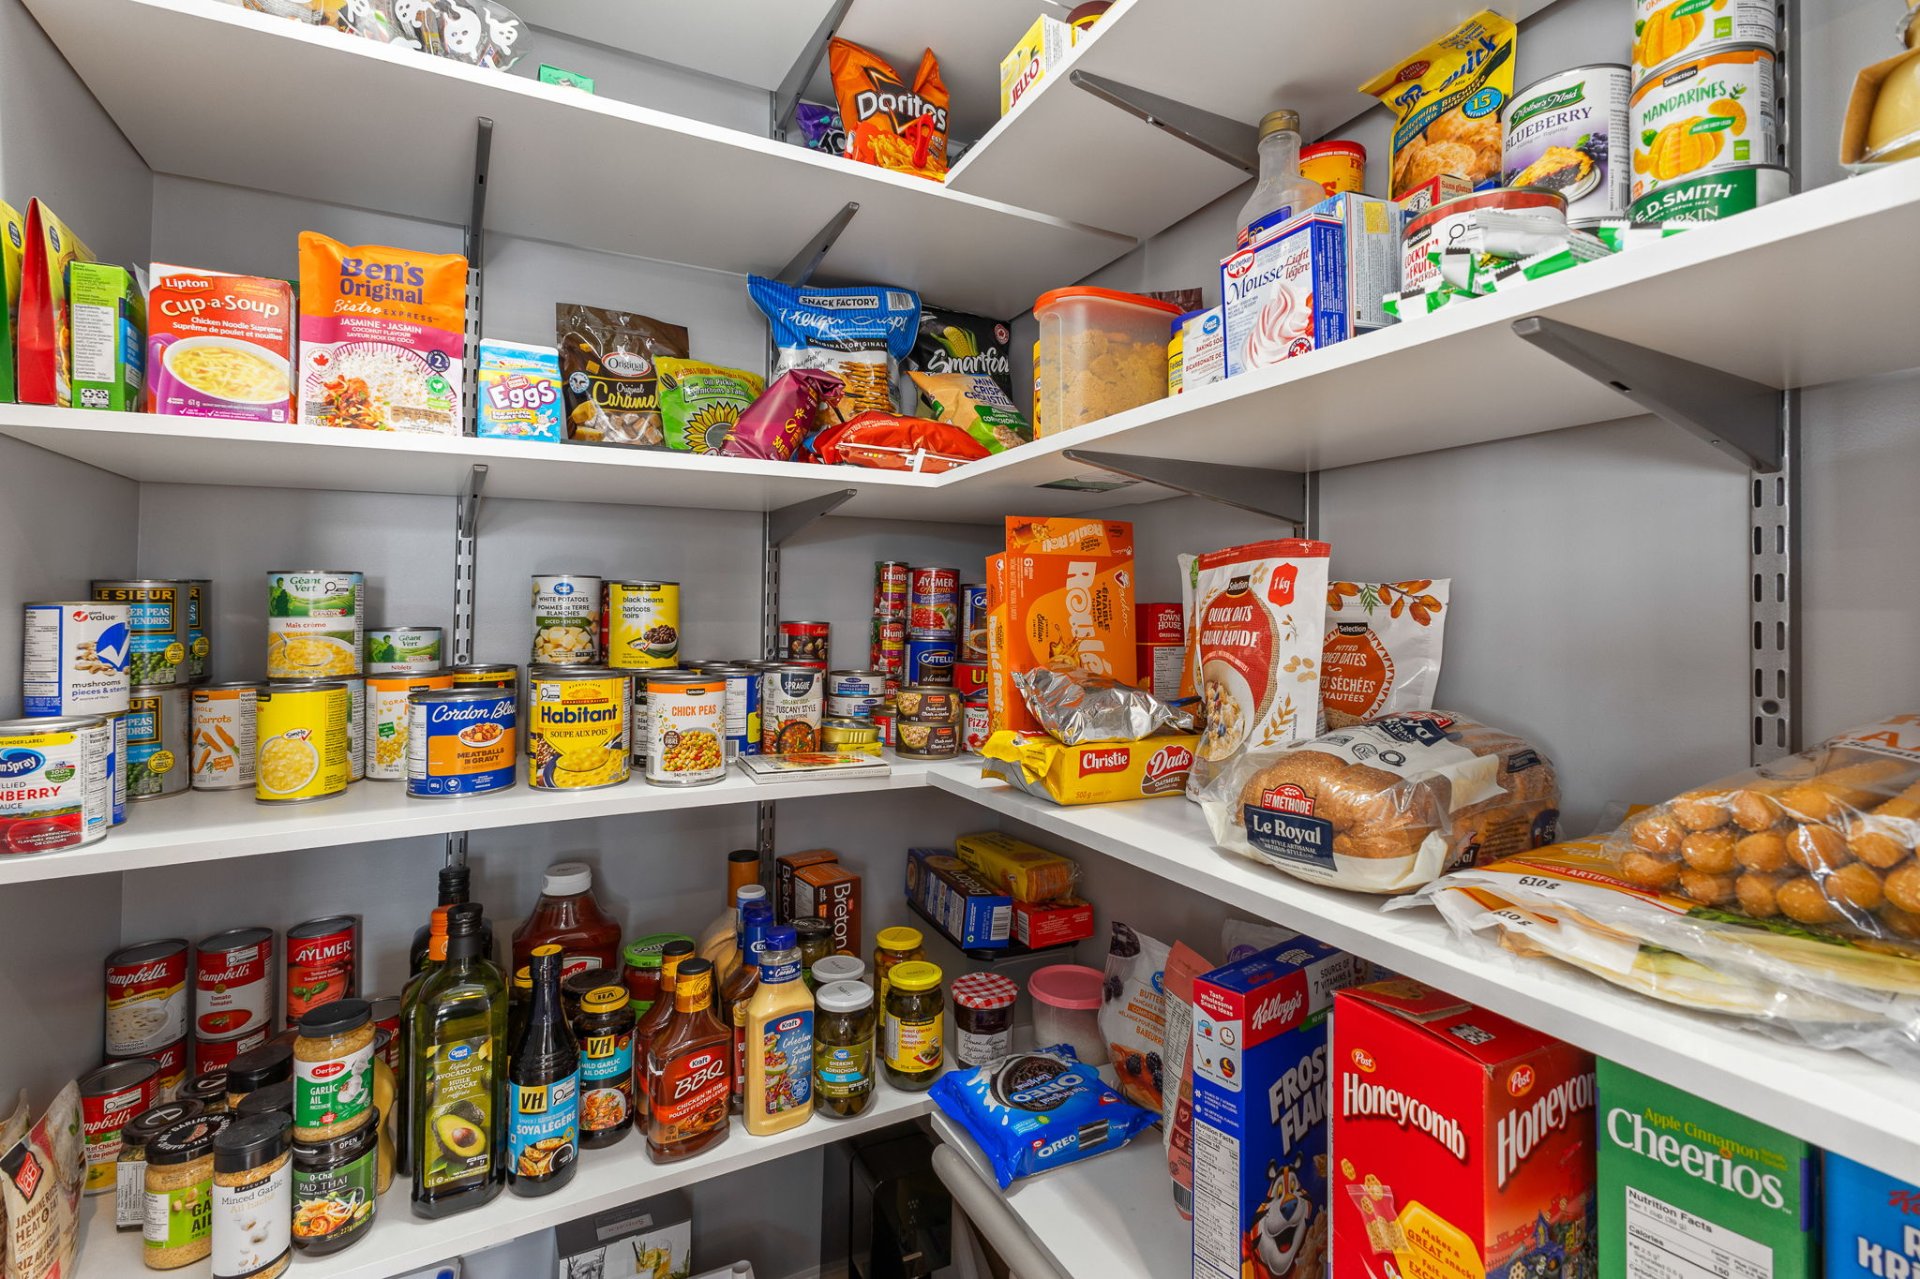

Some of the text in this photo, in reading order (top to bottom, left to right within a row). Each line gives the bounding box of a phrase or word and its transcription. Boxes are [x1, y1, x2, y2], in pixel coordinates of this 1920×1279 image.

[1010, 58, 1040, 107] JELL-O
[1663, 68, 1697, 85] Selection
[858, 91, 947, 130] Doritos
[1472, 94, 1491, 111] 15
[1642, 80, 1728, 126] MANDARINES
[1505, 106, 1593, 152] BLUEBERRY
[340, 257, 425, 288] Ben's
[1227, 248, 1310, 305] Mousse Light
[165, 278, 209, 290] Lipton
[339, 277, 423, 306] Original
[334, 298, 433, 323] Bistro EXPRESS
[802, 297, 877, 307] SNACK FACTORY
[172, 321, 207, 333] Suprême
[220, 328, 244, 338] poulet
[254, 332, 283, 341] nouilles
[191, 317, 283, 335] Chicken Noodle Supreme
[340, 318, 422, 335] JASMINE JASMIN
[352, 327, 382, 336] COCONUT
[396, 337, 415, 345] COCO
[434, 356, 443, 368] 2
[608, 360, 645, 371] Original
[491, 380, 555, 409] Eggs
[593, 381, 659, 410] Carame
[616, 382, 645, 397] Original
[290, 576, 321, 585] Géant
[294, 584, 317, 592] Vert
[116, 590, 173, 600] SIEUR
[89, 613, 116, 621] value
[147, 608, 169, 616] PEAS
[622, 605, 651, 613] haricots
[1158, 613, 1181, 622] TOWN
[1208, 605, 1253, 625] QUICK OATS
[1158, 621, 1182, 630] HOUSE
[1339, 625, 1367, 633] Selection
[398, 634, 422, 642] Géant
[1221, 630, 1260, 648] RAPIDE
[1339, 652, 1367, 667] DATES
[72, 679, 121, 689] mushrooms
[72, 686, 109, 697] pieces &
[1330, 674, 1376, 693] SÉCHÉES
[432, 704, 490, 723] Cordon
[541, 704, 618, 724] Habitant
[671, 704, 717, 717] CHICK PEAS
[776, 704, 817, 714] TUSCANY STYLE
[128, 717, 152, 726] PEAS
[198, 715, 232, 724] Carrots
[550, 728, 608, 738] SOUPE AUX POIS
[457, 747, 505, 760] MEATBALLS
[472, 755, 499, 764] GRAVY
[1082, 751, 1128, 770] Christie
[8, 757, 36, 773] Spray
[1150, 750, 1190, 776] Dad's
[1155, 776, 1181, 787] OATMEAL
[1252, 814, 1321, 845] Le Royal
[1519, 876, 1547, 887] 610
[833, 882, 851, 949] Breton
[295, 940, 352, 962] AYLMER
[107, 964, 167, 987] Campbell's
[198, 964, 250, 984] Campbell's
[1313, 959, 1343, 995] 7 SOURCE
[1320, 972, 1346, 990] VITAMINS
[210, 994, 232, 1002] Tomato
[210, 999, 233, 1007] Tomates
[1200, 993, 1233, 1011] Wholesome
[1209, 990, 1225, 1001] Tasty
[1200, 999, 1234, 1017] Snack Ideas
[1252, 990, 1302, 1031] Kellogg's
[781, 1019, 798, 1030] Kraft
[591, 1038, 613, 1054] VH
[597, 1058, 621, 1068] GARLIC
[692, 1056, 708, 1067] Kraft
[1354, 1052, 1373, 1067] Post
[436, 1064, 485, 1081] AVOCADO OIL
[594, 1066, 618, 1076] DOUCE
[674, 1060, 725, 1099] BBQ
[1012, 1073, 1084, 1102] OREO
[1511, 1068, 1531, 1093] Post
[310, 1084, 339, 1096] GARLIC
[677, 1082, 723, 1110] CHICKEN RIB
[310, 1097, 322, 1105] AIL
[521, 1091, 544, 1111] VH
[669, 1107, 690, 1119] POULET
[1342, 1072, 1466, 1162] Honeycomb
[516, 1110, 576, 1135] SOYA LÉGÈRE
[1644, 1106, 1761, 1162] Apple Cinnamon
[339, 1138, 358, 1150] OPEN
[1038, 1134, 1076, 1158] OREO
[1606, 1106, 1784, 1210] Cheerios
[221, 1178, 283, 1206] Minced Garlic
[300, 1177, 348, 1192] PAD THAI
[16, 1199, 45, 1229] JASMINE
[1628, 1190, 1713, 1233] Nutrition Facts
[16, 1215, 41, 1243] HEAT
[1407, 1229, 1442, 1258] GREAT
[1421, 1226, 1451, 1252] Makes
[1628, 1224, 1730, 1278] Calories 150
